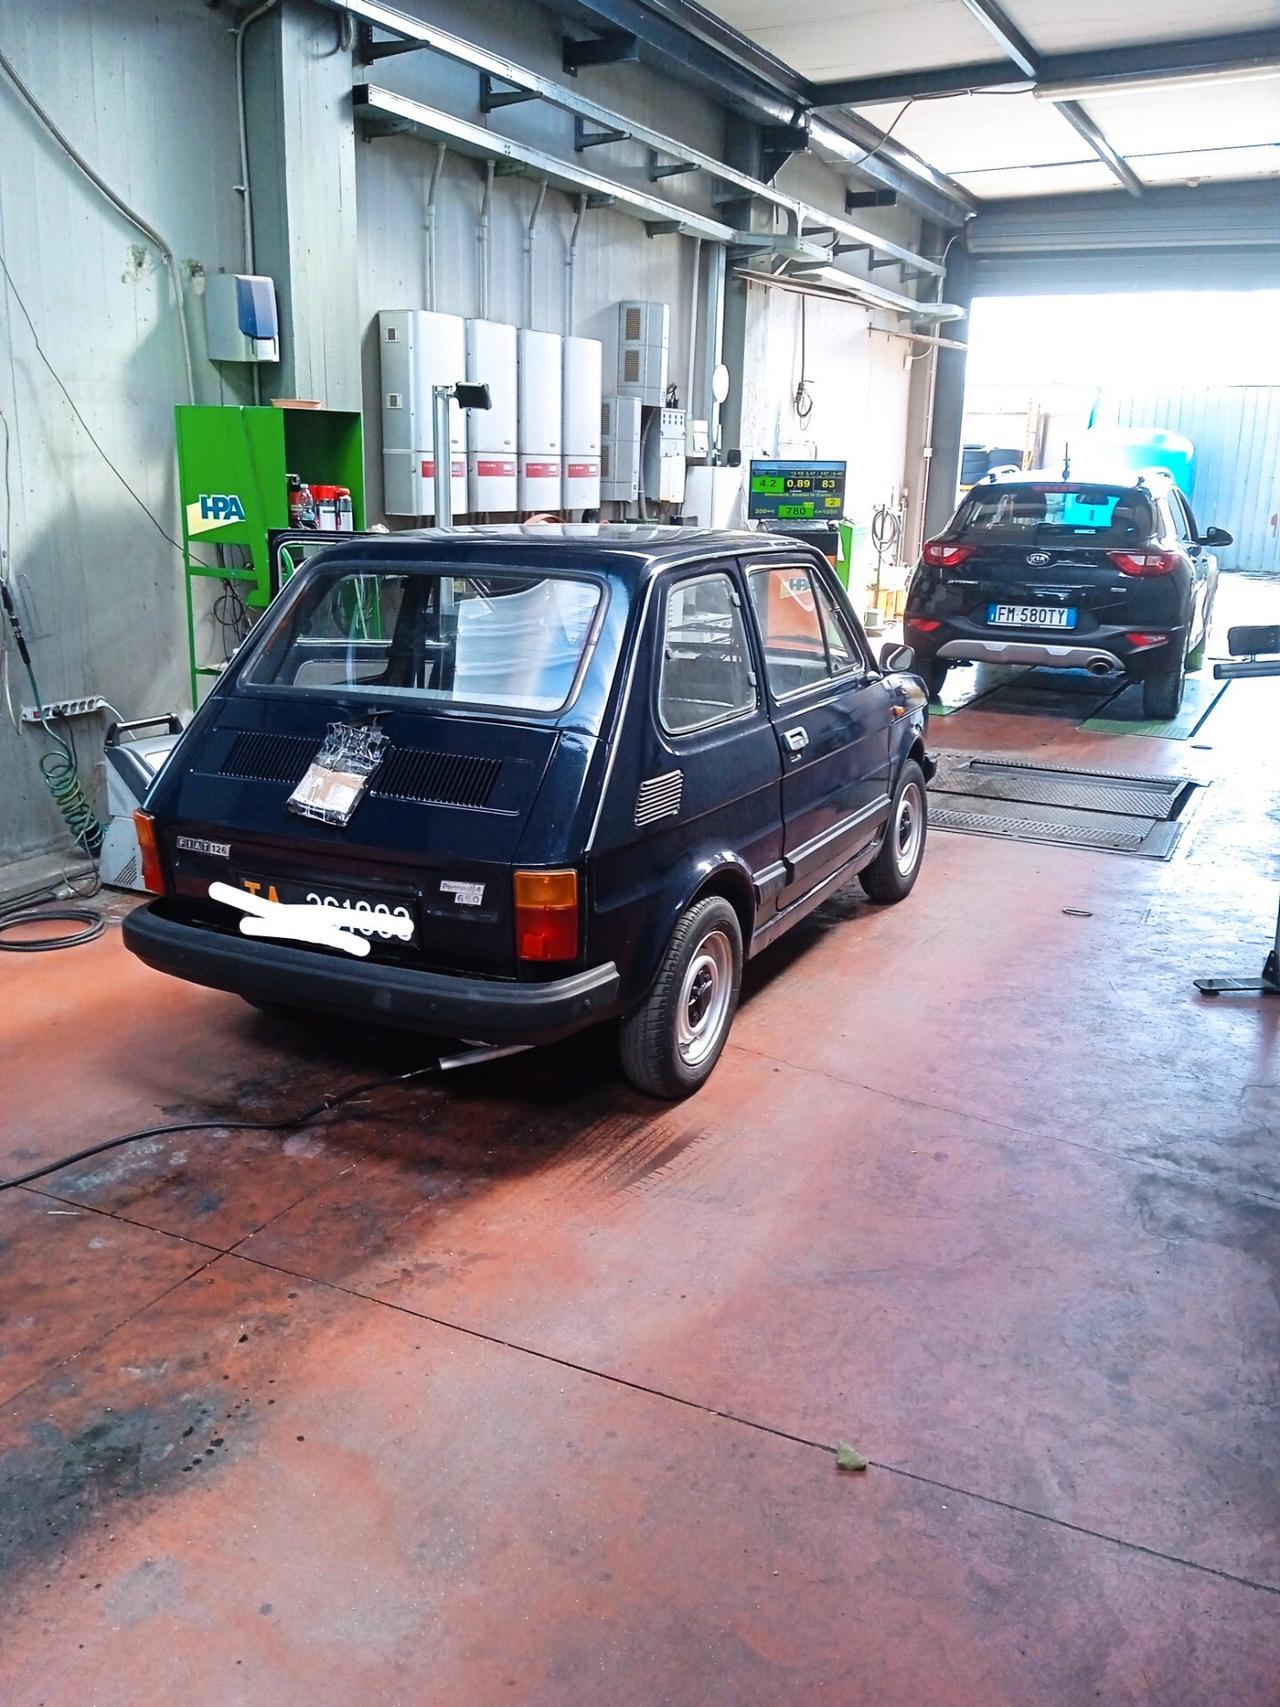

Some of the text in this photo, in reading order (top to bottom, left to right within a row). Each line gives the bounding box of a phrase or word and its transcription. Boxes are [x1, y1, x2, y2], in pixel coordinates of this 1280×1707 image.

[786, 479, 811, 489] 0.89
[821, 479, 836, 488] 83
[830, 498, 836, 506] 2
[199, 495, 245, 521] HPA
[786, 506, 806, 516] 780
[998, 607, 1066, 624] FM 580TY
[178, 838, 229, 855] FIAT 126
[457, 894, 480, 903] 60
